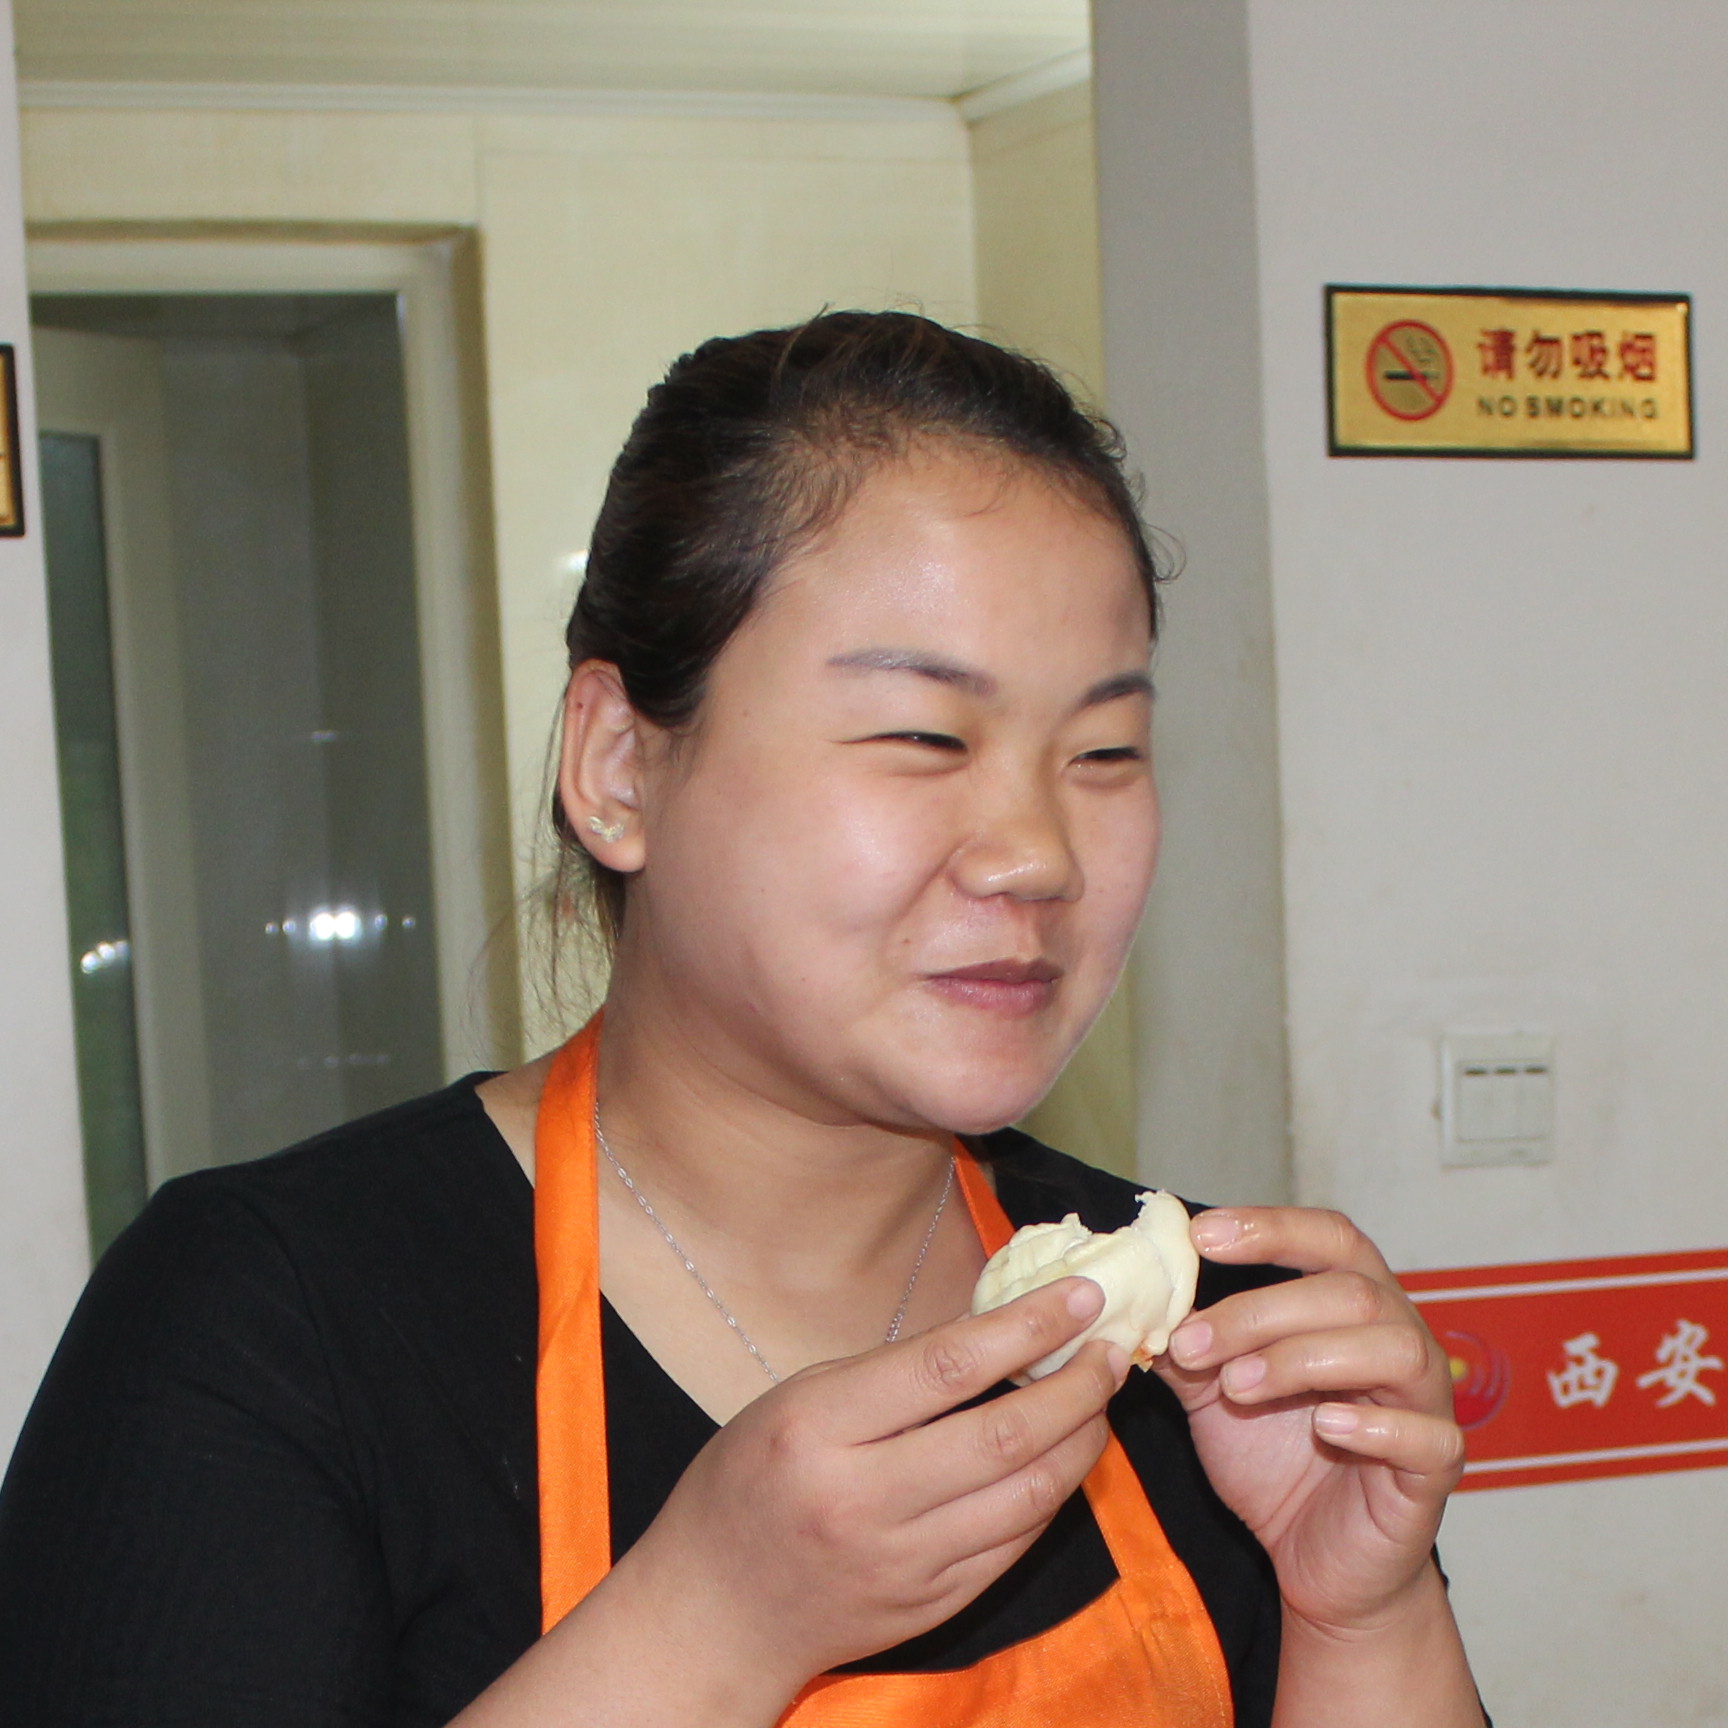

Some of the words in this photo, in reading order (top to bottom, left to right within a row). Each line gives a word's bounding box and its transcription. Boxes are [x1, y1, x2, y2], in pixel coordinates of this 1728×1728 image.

[1477, 329, 1658, 382] 请勿吸烟
[1477, 396, 1516, 418] NO
[1525, 396, 1659, 420] SMOKING
